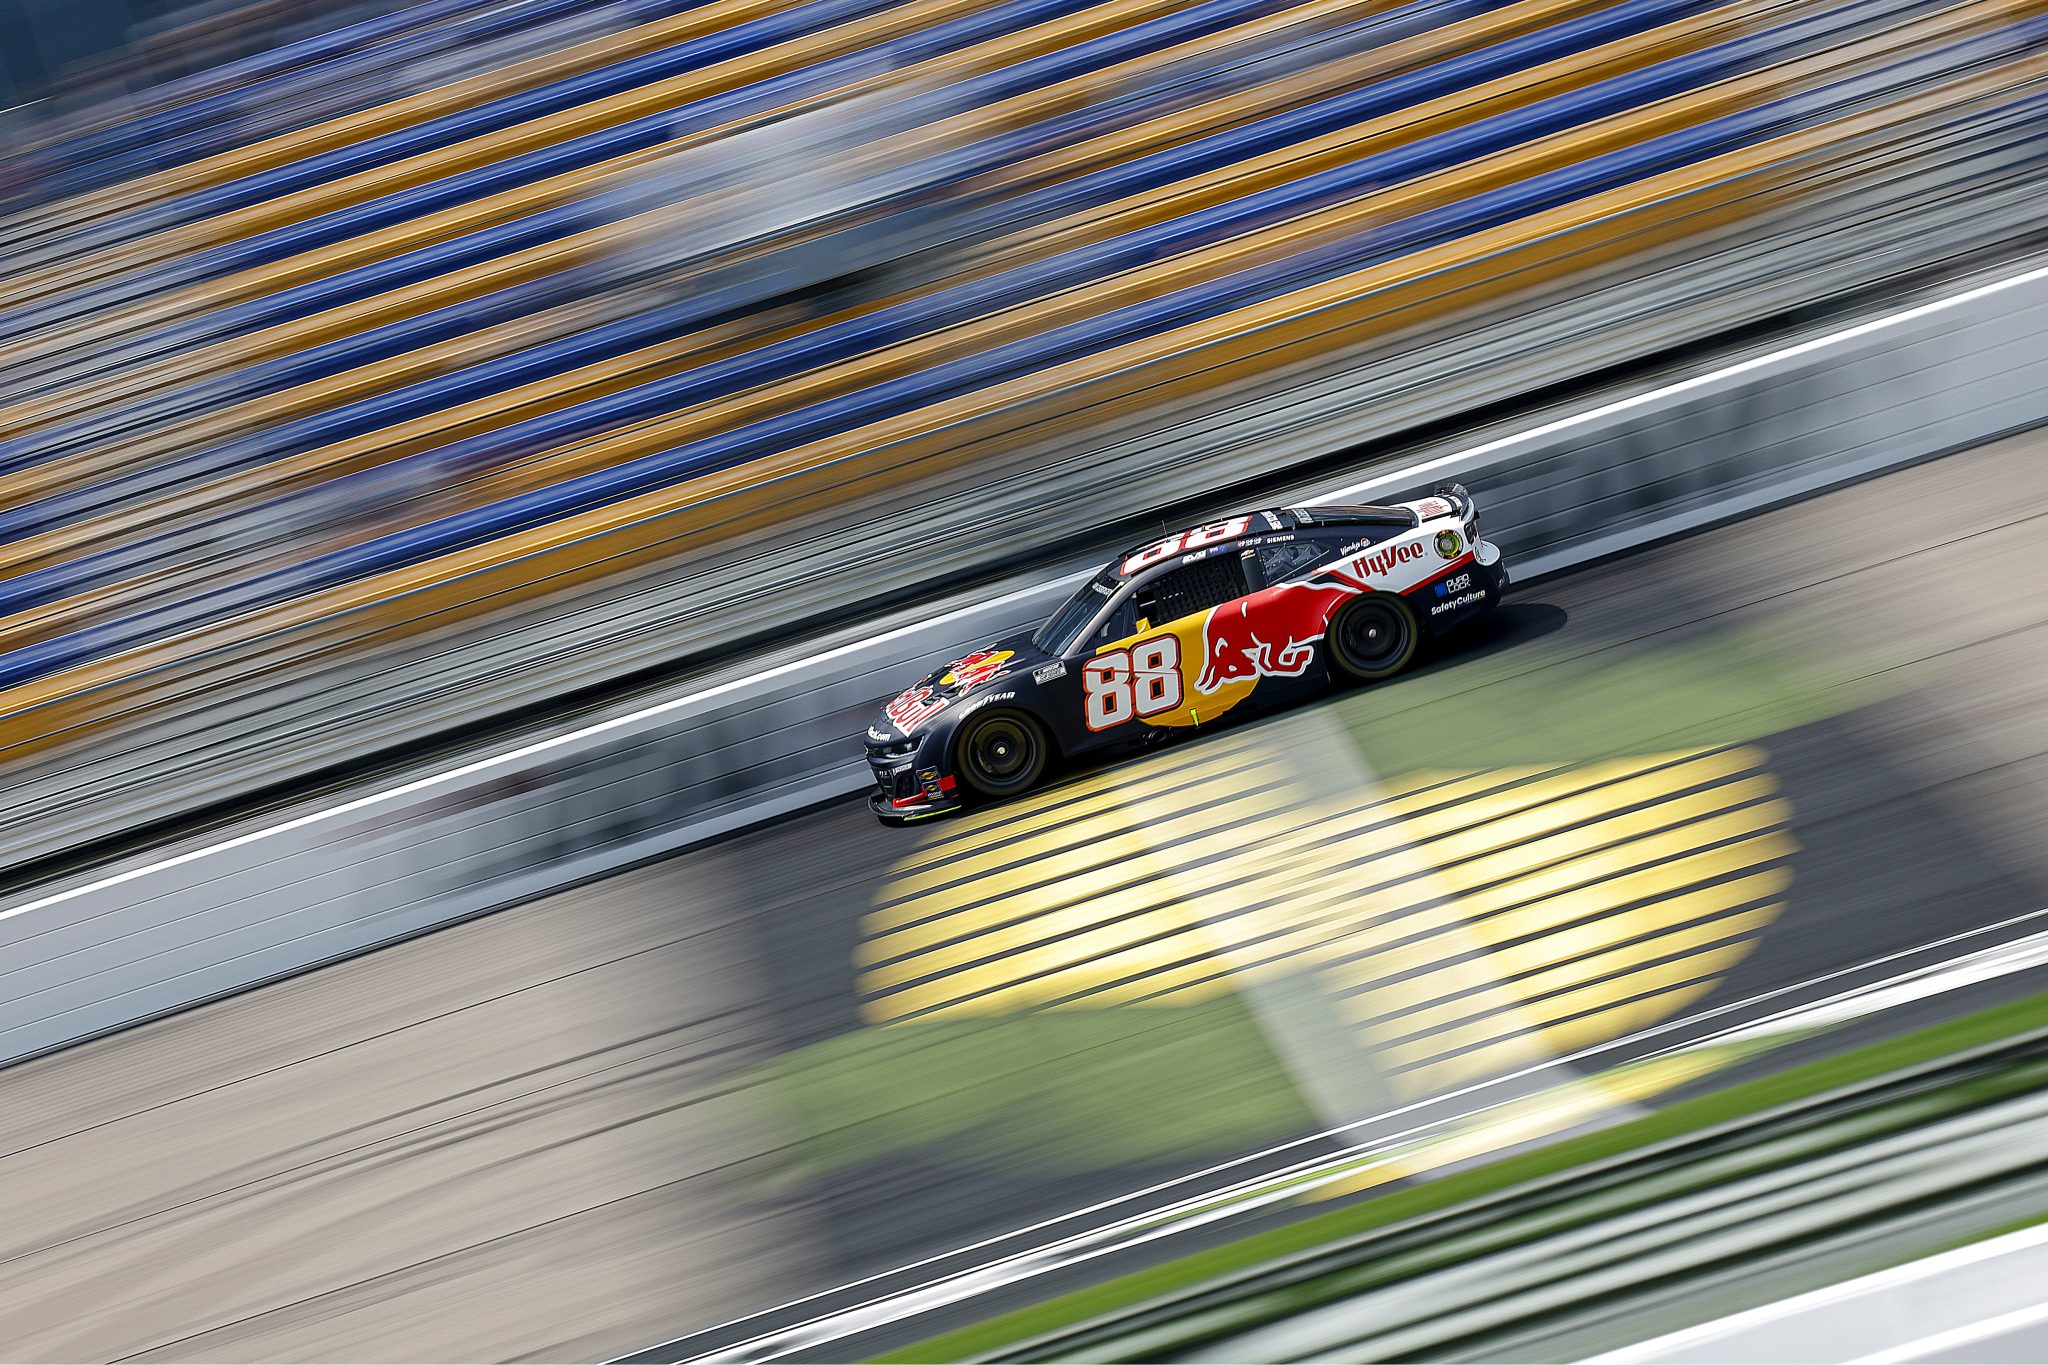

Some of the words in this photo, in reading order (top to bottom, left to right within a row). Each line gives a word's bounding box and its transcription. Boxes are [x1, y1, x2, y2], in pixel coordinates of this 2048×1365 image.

[1446, 573, 1470, 589] QUAD
[1447, 580, 1472, 594] LOCK
[1431, 589, 1487, 616] SafetyCulture
[1082, 633, 1185, 732] 88
